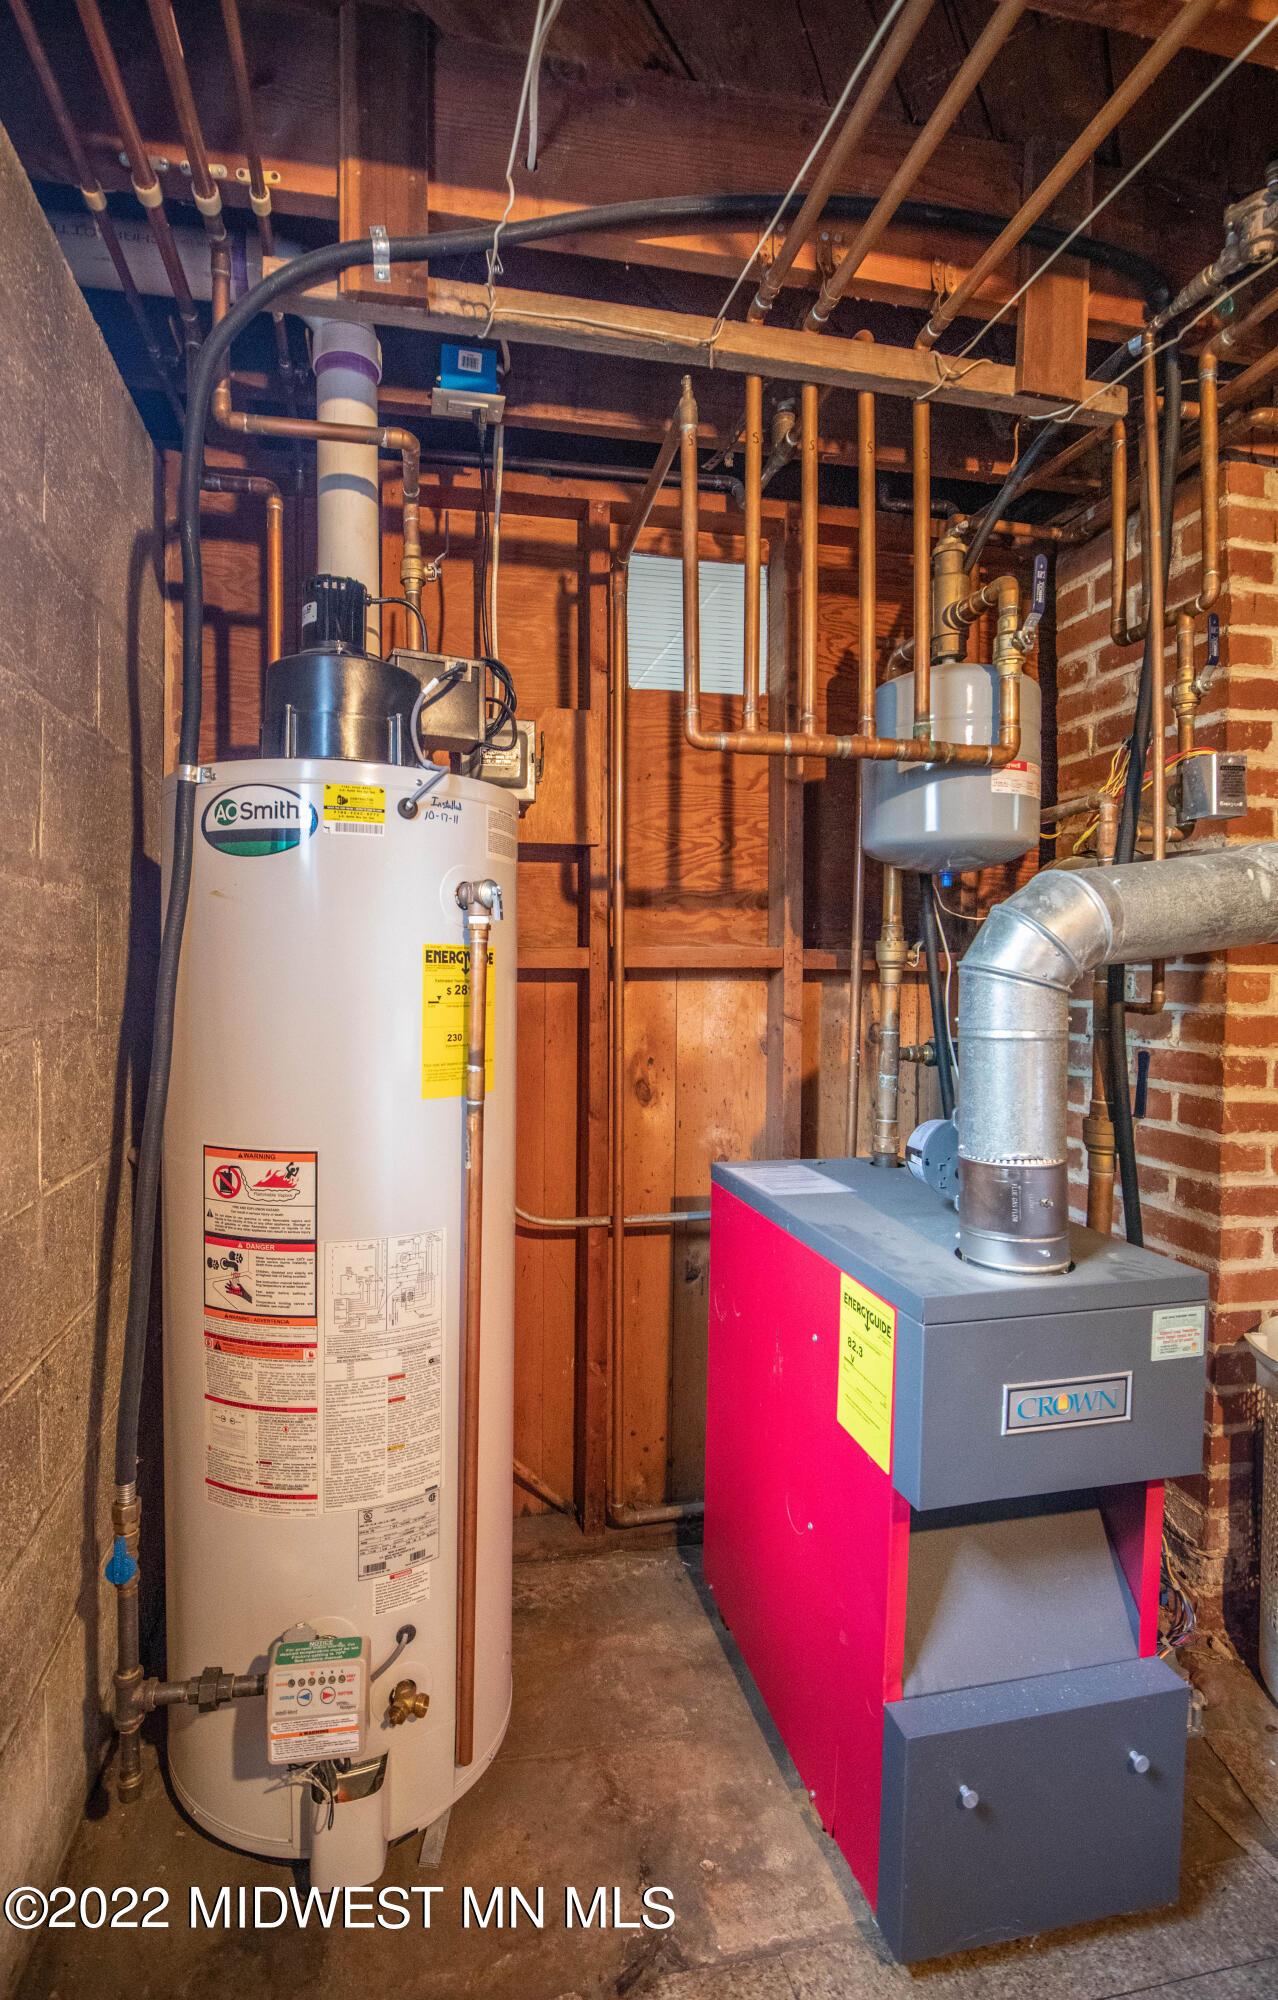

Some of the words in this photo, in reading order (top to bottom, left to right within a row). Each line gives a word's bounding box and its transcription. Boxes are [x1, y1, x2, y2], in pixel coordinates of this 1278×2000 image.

[240, 800, 300, 820] Smith
[425, 810, 459, 824] 10-17-11
[455, 985, 470, 996] 28
[447, 1033, 463, 1043] 230
[844, 1292, 892, 1339] ENERGYGUIDE
[848, 1336, 863, 1358] 82.3
[1017, 1388, 1119, 1420] CROWN
